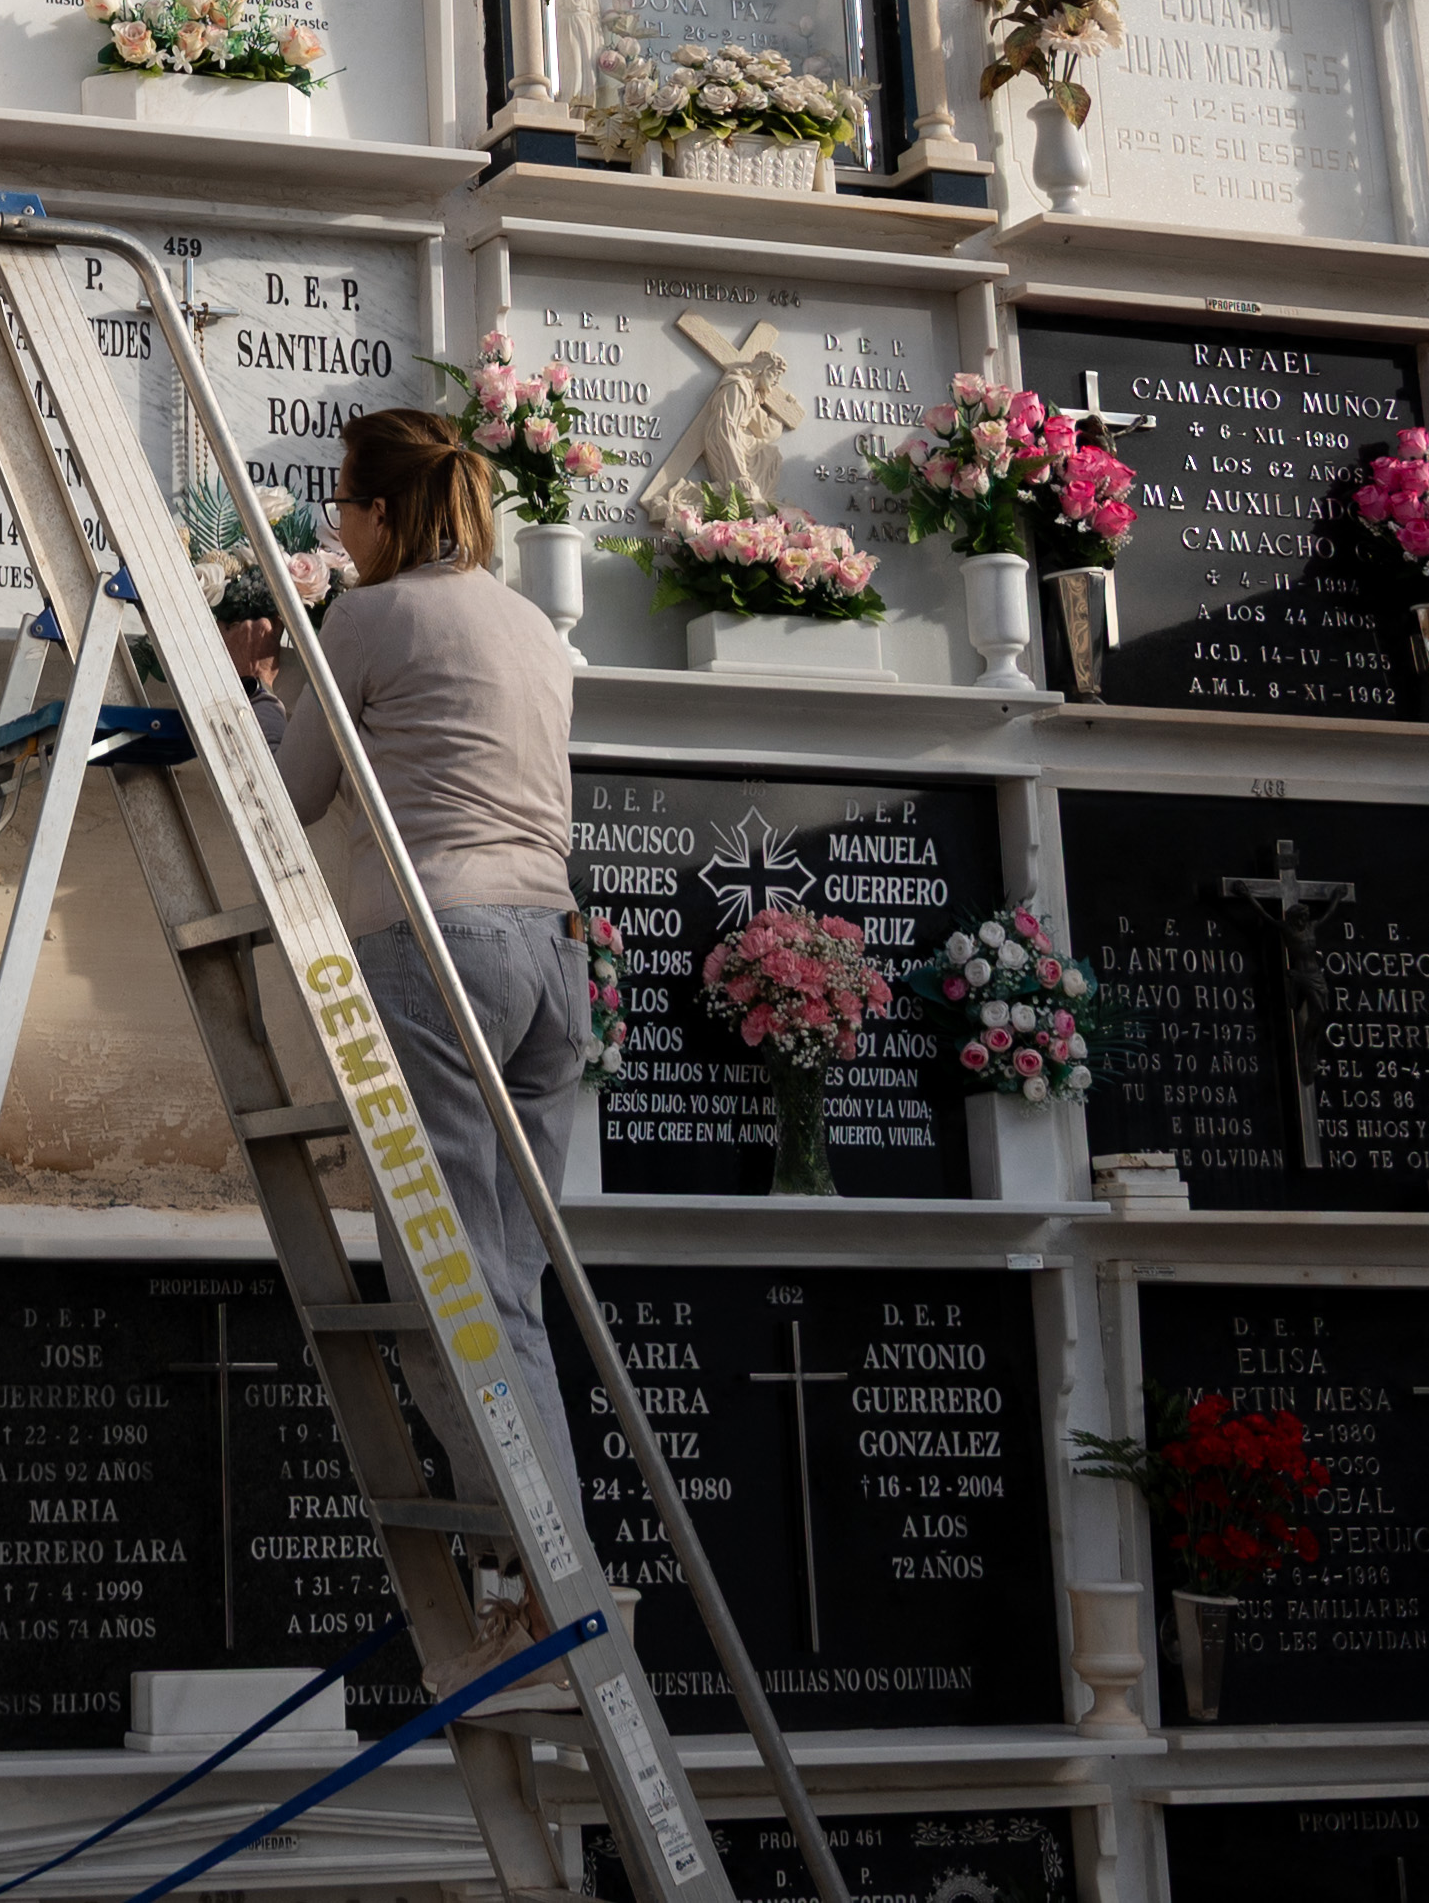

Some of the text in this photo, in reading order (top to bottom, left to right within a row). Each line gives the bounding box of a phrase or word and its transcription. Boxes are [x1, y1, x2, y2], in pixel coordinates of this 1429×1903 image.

[1116, 35, 1341, 96] JUAN MORALES
[163, 236, 202, 257] 459
[644, 277, 758, 304] PROPIEDAD
[1210, 298, 1259, 314] PROPIEDAD
[237, 330, 393, 377] SANTIAGO
[554, 339, 624, 364] JULIO
[1193, 343, 1321, 376] RAFAEL
[827, 363, 911, 393] MARIA
[817, 396, 926, 428] RAMIREZ
[1132, 376, 1401, 421] CAMACHO MUÑOZ
[828, 834, 938, 865] MANUELA
[590, 865, 678, 896] TORRES
[824, 876, 948, 906] GUERRERO
[864, 917, 915, 945] RUIZ
[606, 1118, 736, 1144] EL QUE CREE EN MÍ,
[304, 951, 500, 1364] CEMENTERIO
[766, 1286, 804, 1305] 462
[41, 1346, 104, 1368] JOSE
[863, 1343, 986, 1370] ANTONIO
[1237, 1348, 1329, 1375] ELISA
[851, 1387, 1003, 1414] GUERRERO
[858, 1431, 1002, 1458] GONZALEZ
[28, 1500, 119, 1523] MARIA
[114, 1540, 188, 1563] LARA
[1297, 1810, 1419, 1834] PROPIEDAD
